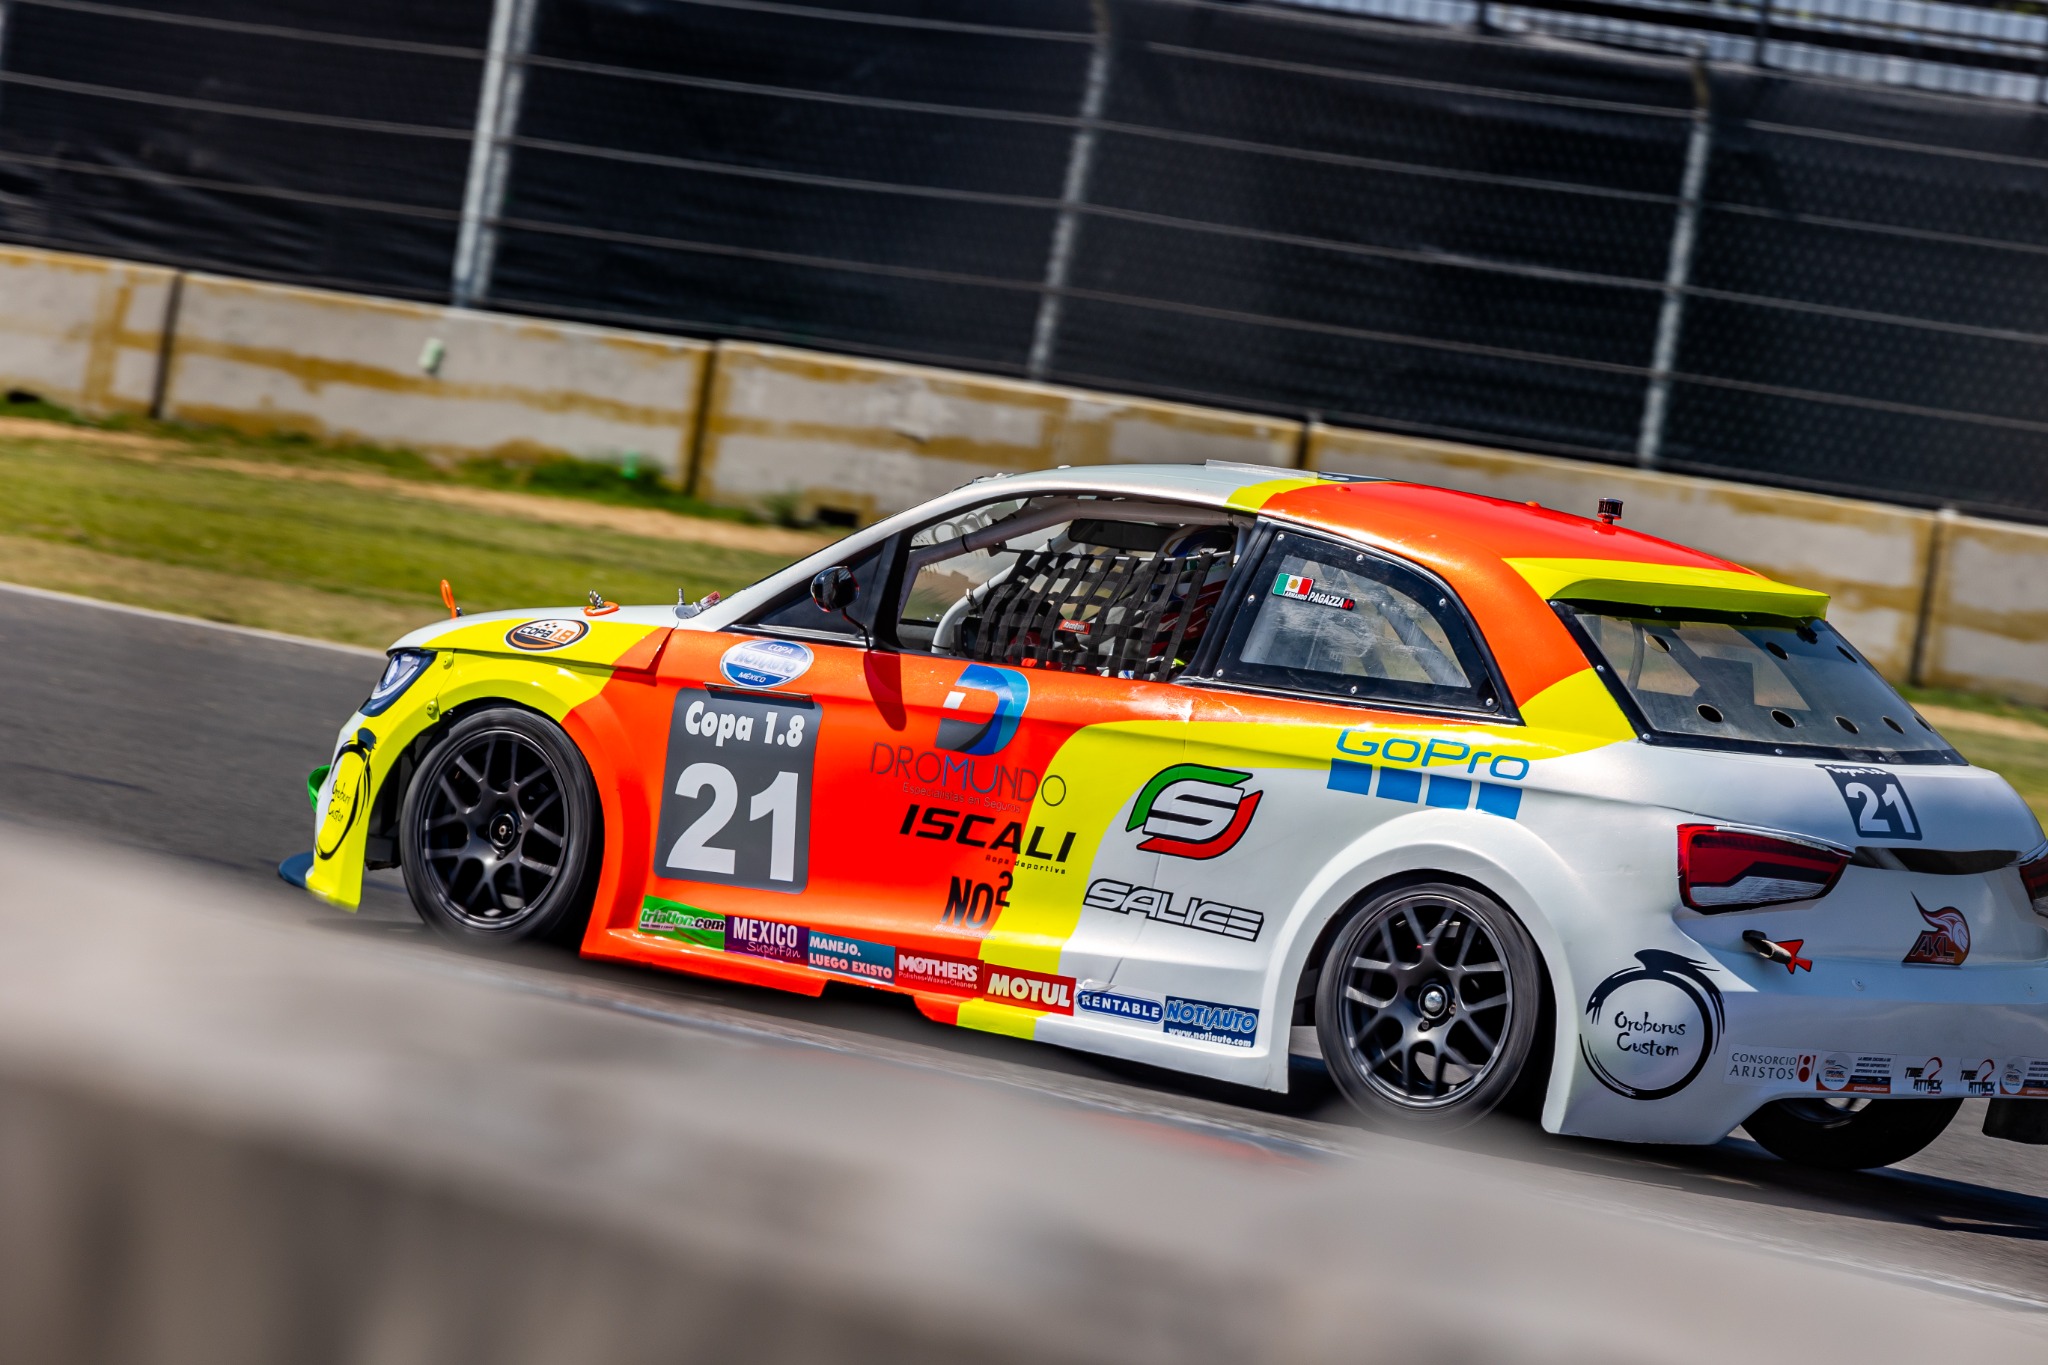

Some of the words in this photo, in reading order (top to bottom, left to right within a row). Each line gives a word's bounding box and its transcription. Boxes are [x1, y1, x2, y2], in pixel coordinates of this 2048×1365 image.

[1284, 590, 1308, 601] ARMANDO
[1308, 591, 1345, 608] PAGAZZA
[767, 643, 795, 655] COPA
[737, 671, 767, 683] MÉXICO
[685, 700, 754, 747] Copa
[763, 711, 806, 748] 1.8
[1336, 727, 1530, 781] GoPro
[869, 741, 1067, 807] DROMUNDO
[902, 782, 965, 803] Especialistas
[967, 795, 981, 806] en
[984, 797, 1021, 814] Seguros
[1845, 781, 1916, 834] 21
[665, 762, 799, 882] 21
[899, 803, 1077, 863] ISCALI
[985, 854, 1010, 865] Ropa
[1013, 859, 1067, 875] deportiva
[1082, 877, 1265, 942] SALICE
[732, 915, 798, 948] MEXICO
[809, 935, 862, 957] MANEJO.
[1909, 934, 1956, 958] AKL
[809, 952, 849, 971] LUEGO
[851, 961, 893, 979] EXISTO
[898, 954, 979, 982] MOTHERS
[987, 972, 1071, 1008] MOTUL
[1081, 993, 1160, 1019] RENTABLE
[1164, 1000, 1258, 1034] NOTIAUTO
[1614, 1010, 1686, 1036] Oroborus
[1168, 1027, 1252, 1048] www.notiauto.com
[1616, 1032, 1680, 1057] Custom
[1729, 1064, 1795, 1080] ARISTOS
[1731, 1052, 1797, 1066] CONSORCIO
[1913, 1078, 1944, 1092] ATTACK
